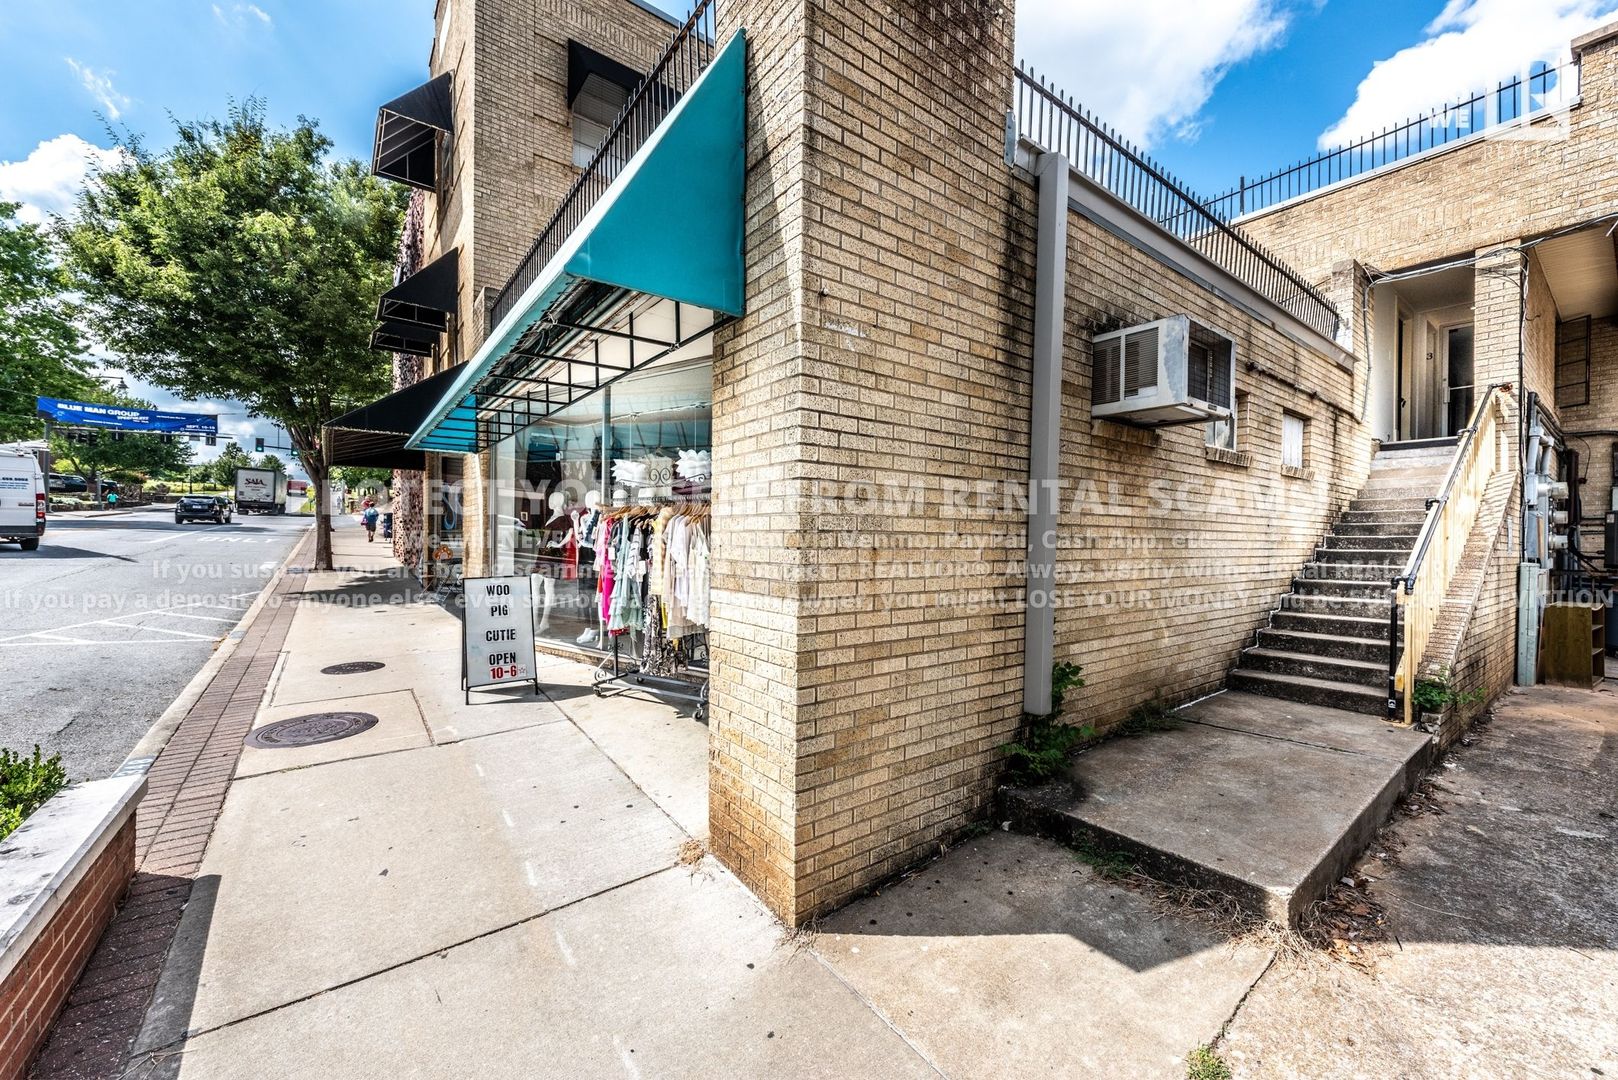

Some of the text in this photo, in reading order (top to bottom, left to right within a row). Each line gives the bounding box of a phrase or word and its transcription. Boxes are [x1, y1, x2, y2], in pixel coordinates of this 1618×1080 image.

[57, 403, 140, 417] BLUE MAN GROUP
[244, 478, 268, 486] SAIA
[486, 585, 510, 596] WOO
[491, 605, 508, 616] PIG
[486, 629, 516, 641] CUTIE
[489, 652, 516, 665] OPEN
[490, 666, 517, 679] 10-6
